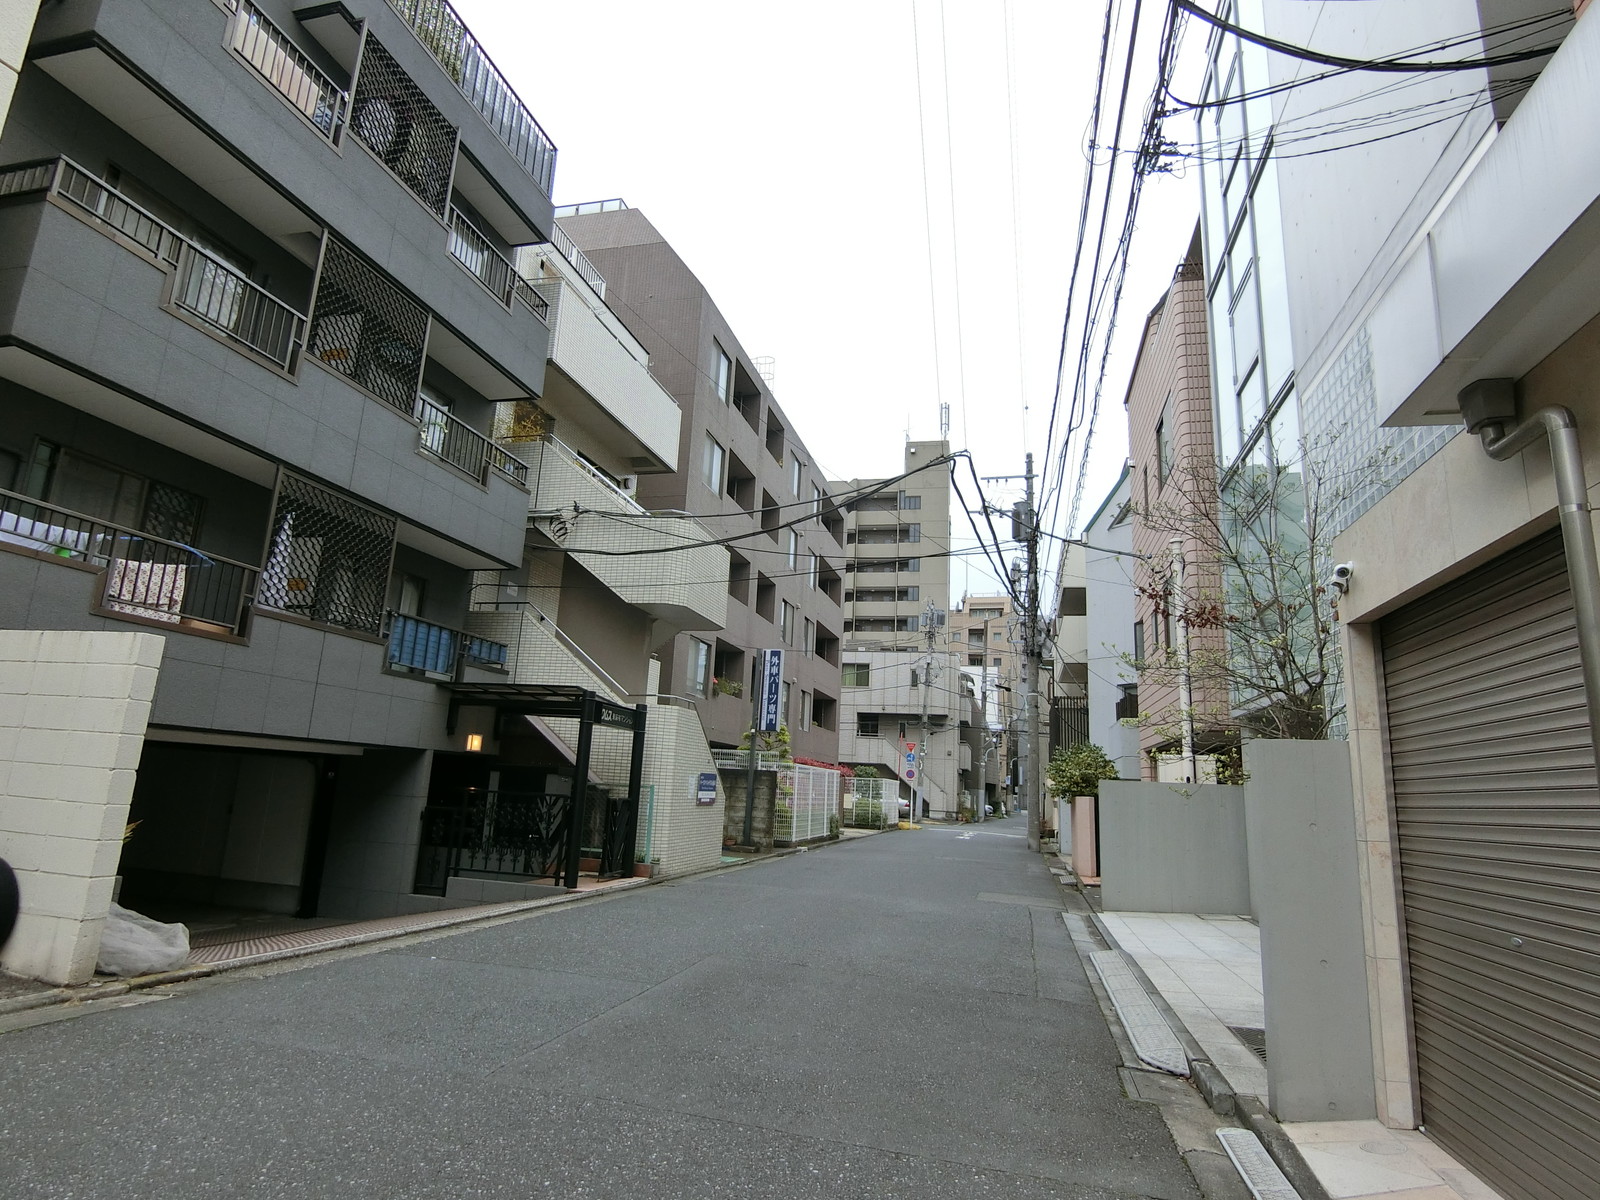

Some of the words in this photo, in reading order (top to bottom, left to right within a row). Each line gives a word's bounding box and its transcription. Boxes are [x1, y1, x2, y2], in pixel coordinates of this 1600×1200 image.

[767, 656, 779, 724] 外車パーツ専門
